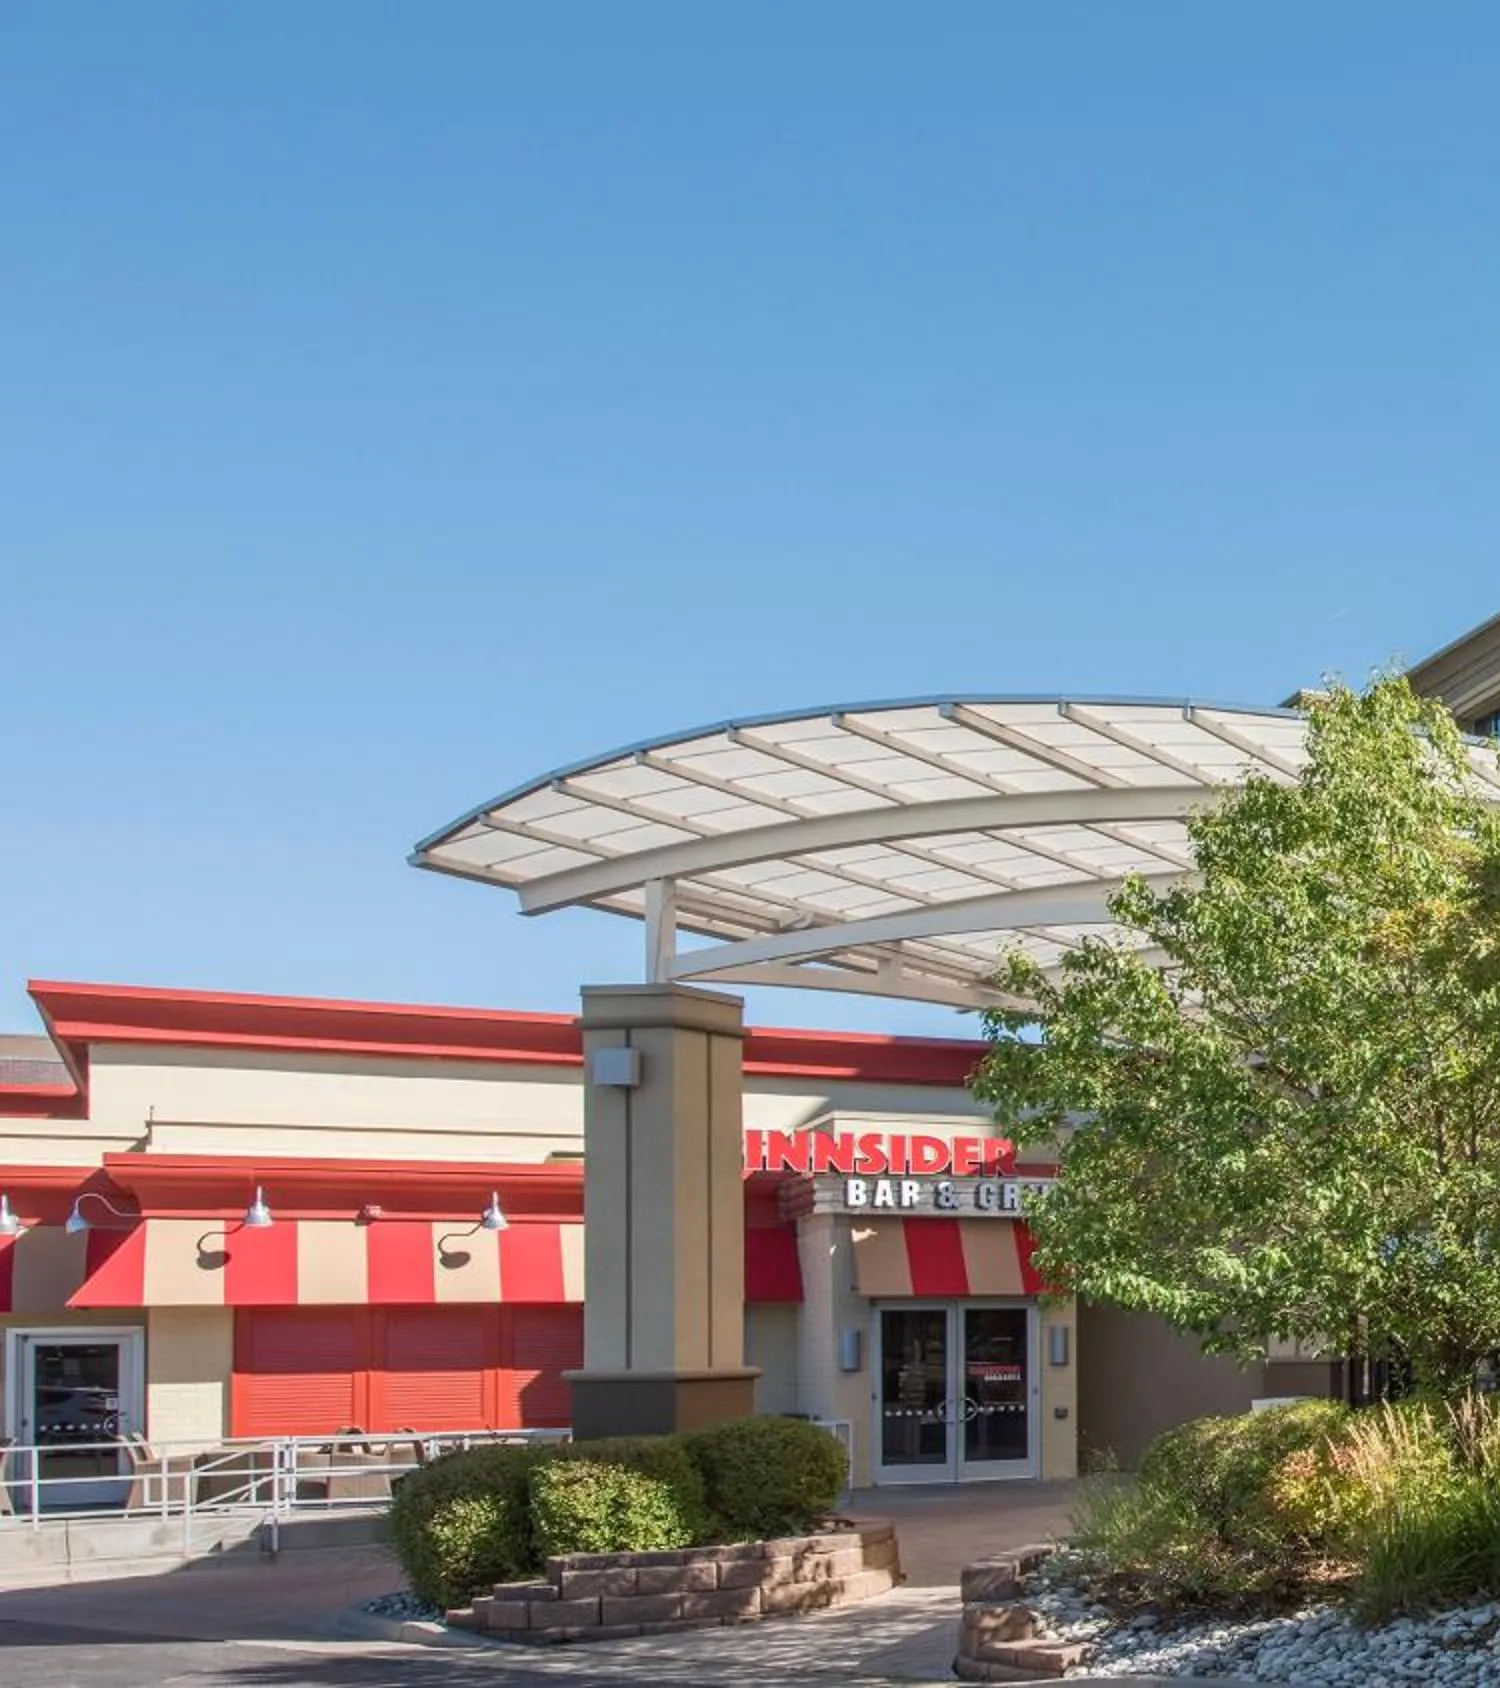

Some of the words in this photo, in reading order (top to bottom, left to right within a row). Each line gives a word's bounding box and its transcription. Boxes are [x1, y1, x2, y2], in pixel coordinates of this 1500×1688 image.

[744, 1129, 1016, 1176] INNSIDER
[847, 1179, 922, 1209] BAR
[936, 1182, 958, 1210] &
